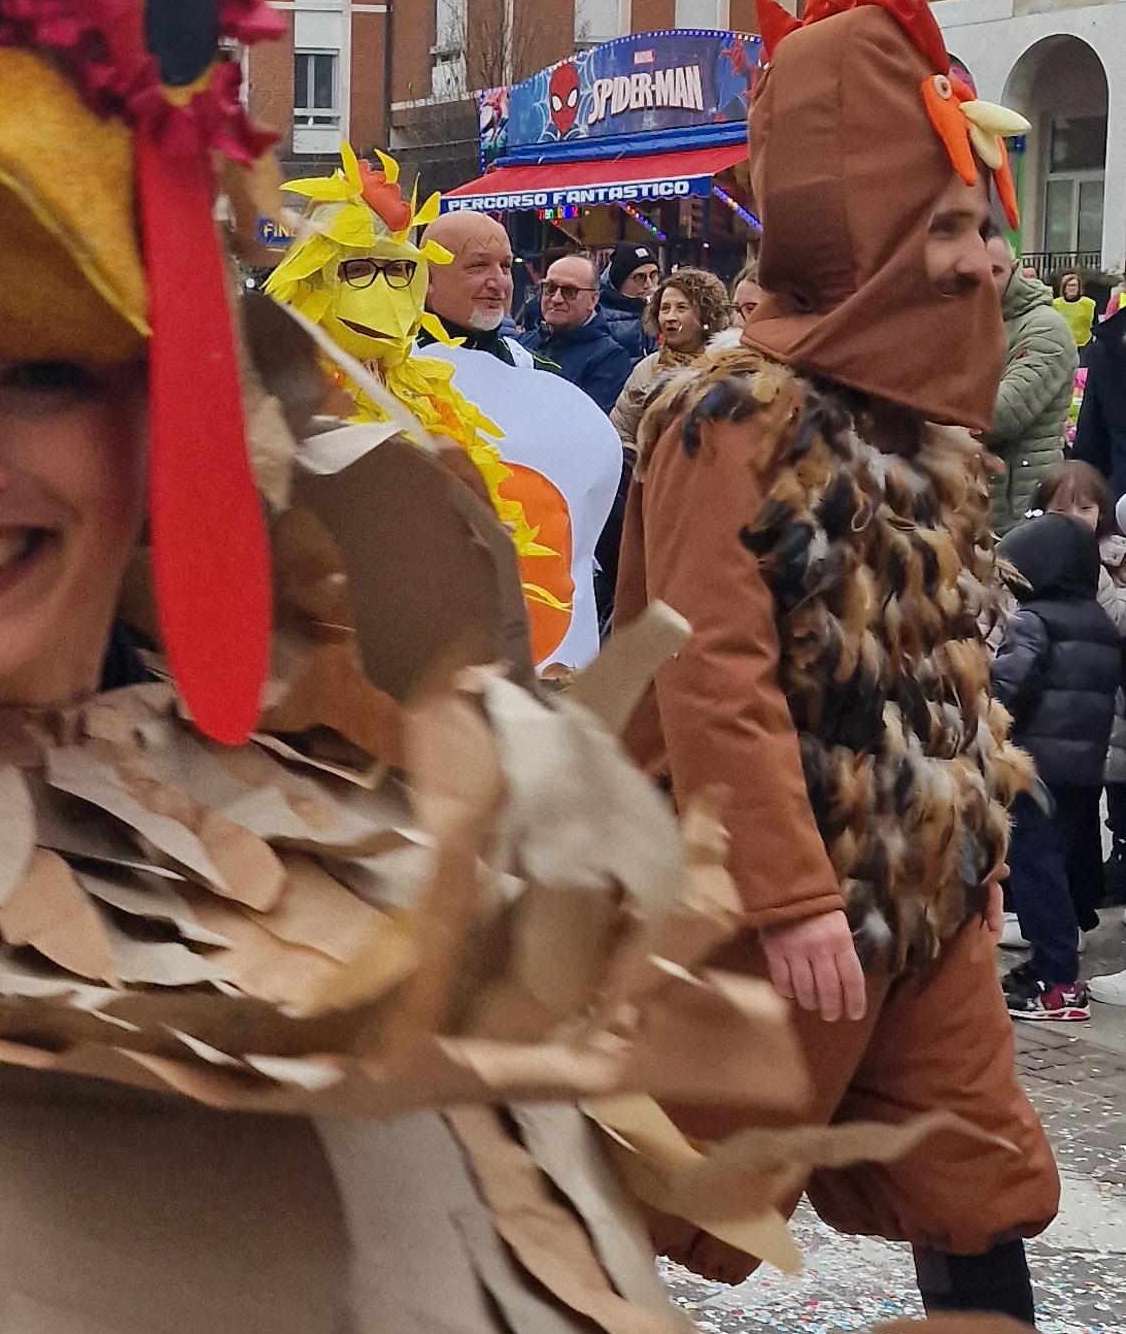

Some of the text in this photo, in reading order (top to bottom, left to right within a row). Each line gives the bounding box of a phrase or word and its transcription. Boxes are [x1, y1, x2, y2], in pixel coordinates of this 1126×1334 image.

[587, 65, 704, 124] SPIDER-MAN
[448, 181, 689, 211] PERCORSO FANTASTICO
